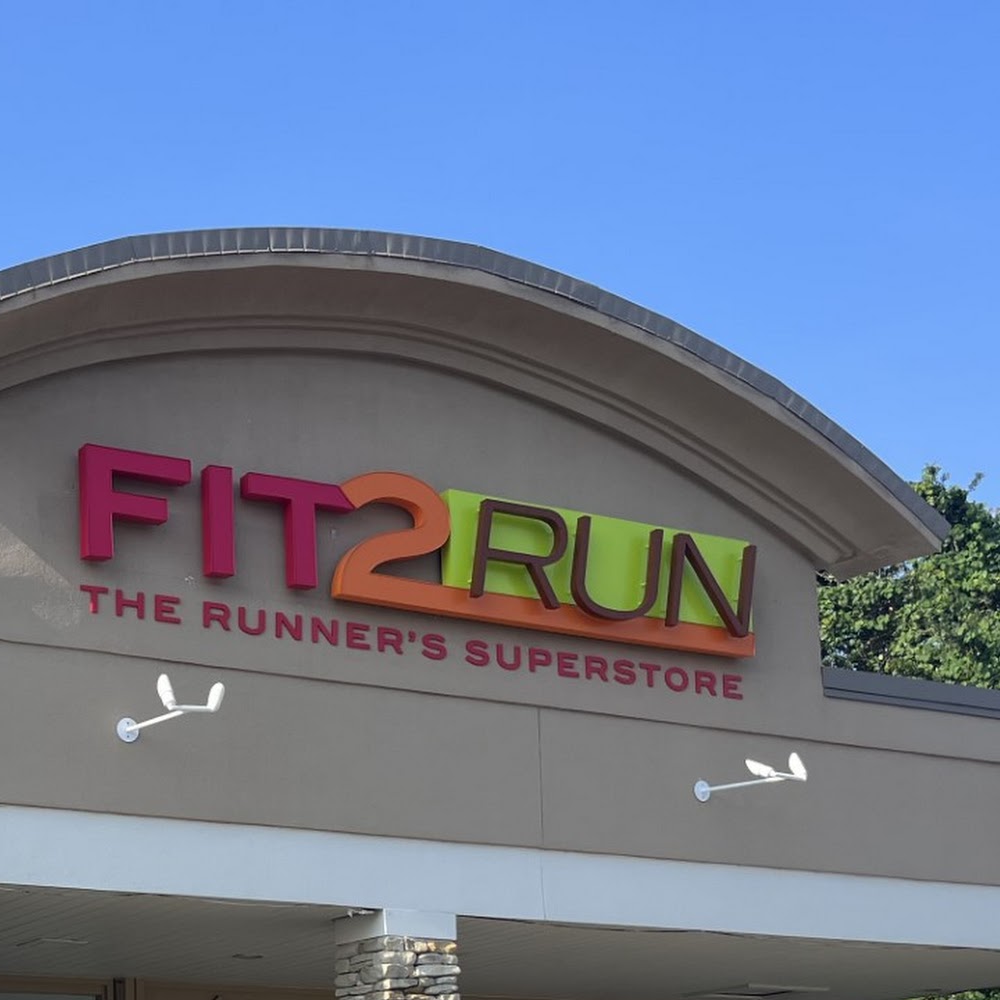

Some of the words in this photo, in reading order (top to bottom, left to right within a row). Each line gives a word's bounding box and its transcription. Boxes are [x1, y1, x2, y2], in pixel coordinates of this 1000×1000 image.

[78, 443, 757, 656] FIT2RUN
[79, 584, 181, 625] THE
[202, 601, 448, 661] RUNNER'S
[465, 639, 744, 700] SUPERSTORE
